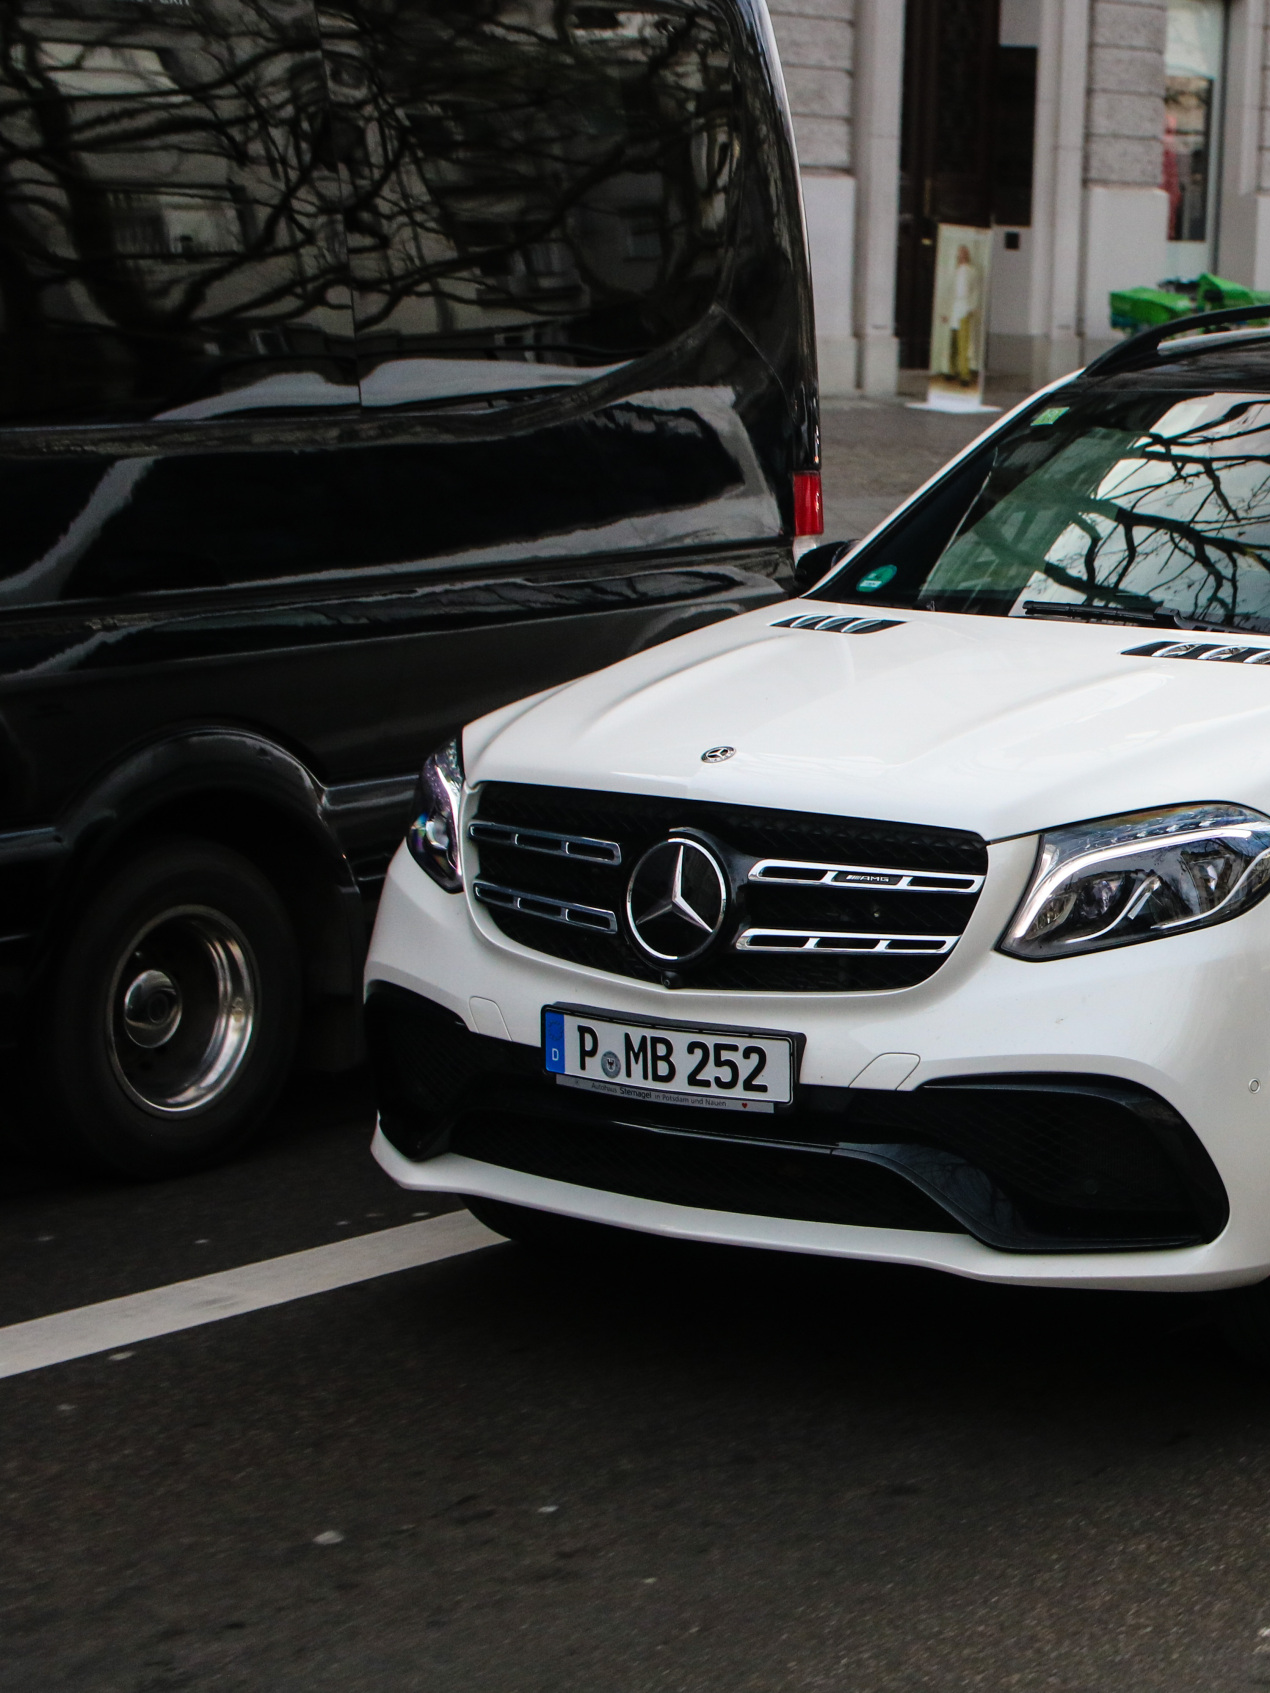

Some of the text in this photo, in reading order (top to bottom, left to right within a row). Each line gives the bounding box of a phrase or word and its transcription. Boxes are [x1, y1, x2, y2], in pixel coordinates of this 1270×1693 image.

[552, 1048, 560, 1061] D
[577, 1024, 769, 1093] P MB 252
[591, 1082, 618, 1093] Autohaus
[620, 1087, 652, 1099] Sternagel
[662, 1094, 690, 1103] Potsdam
[705, 1098, 727, 1107] Nauen
